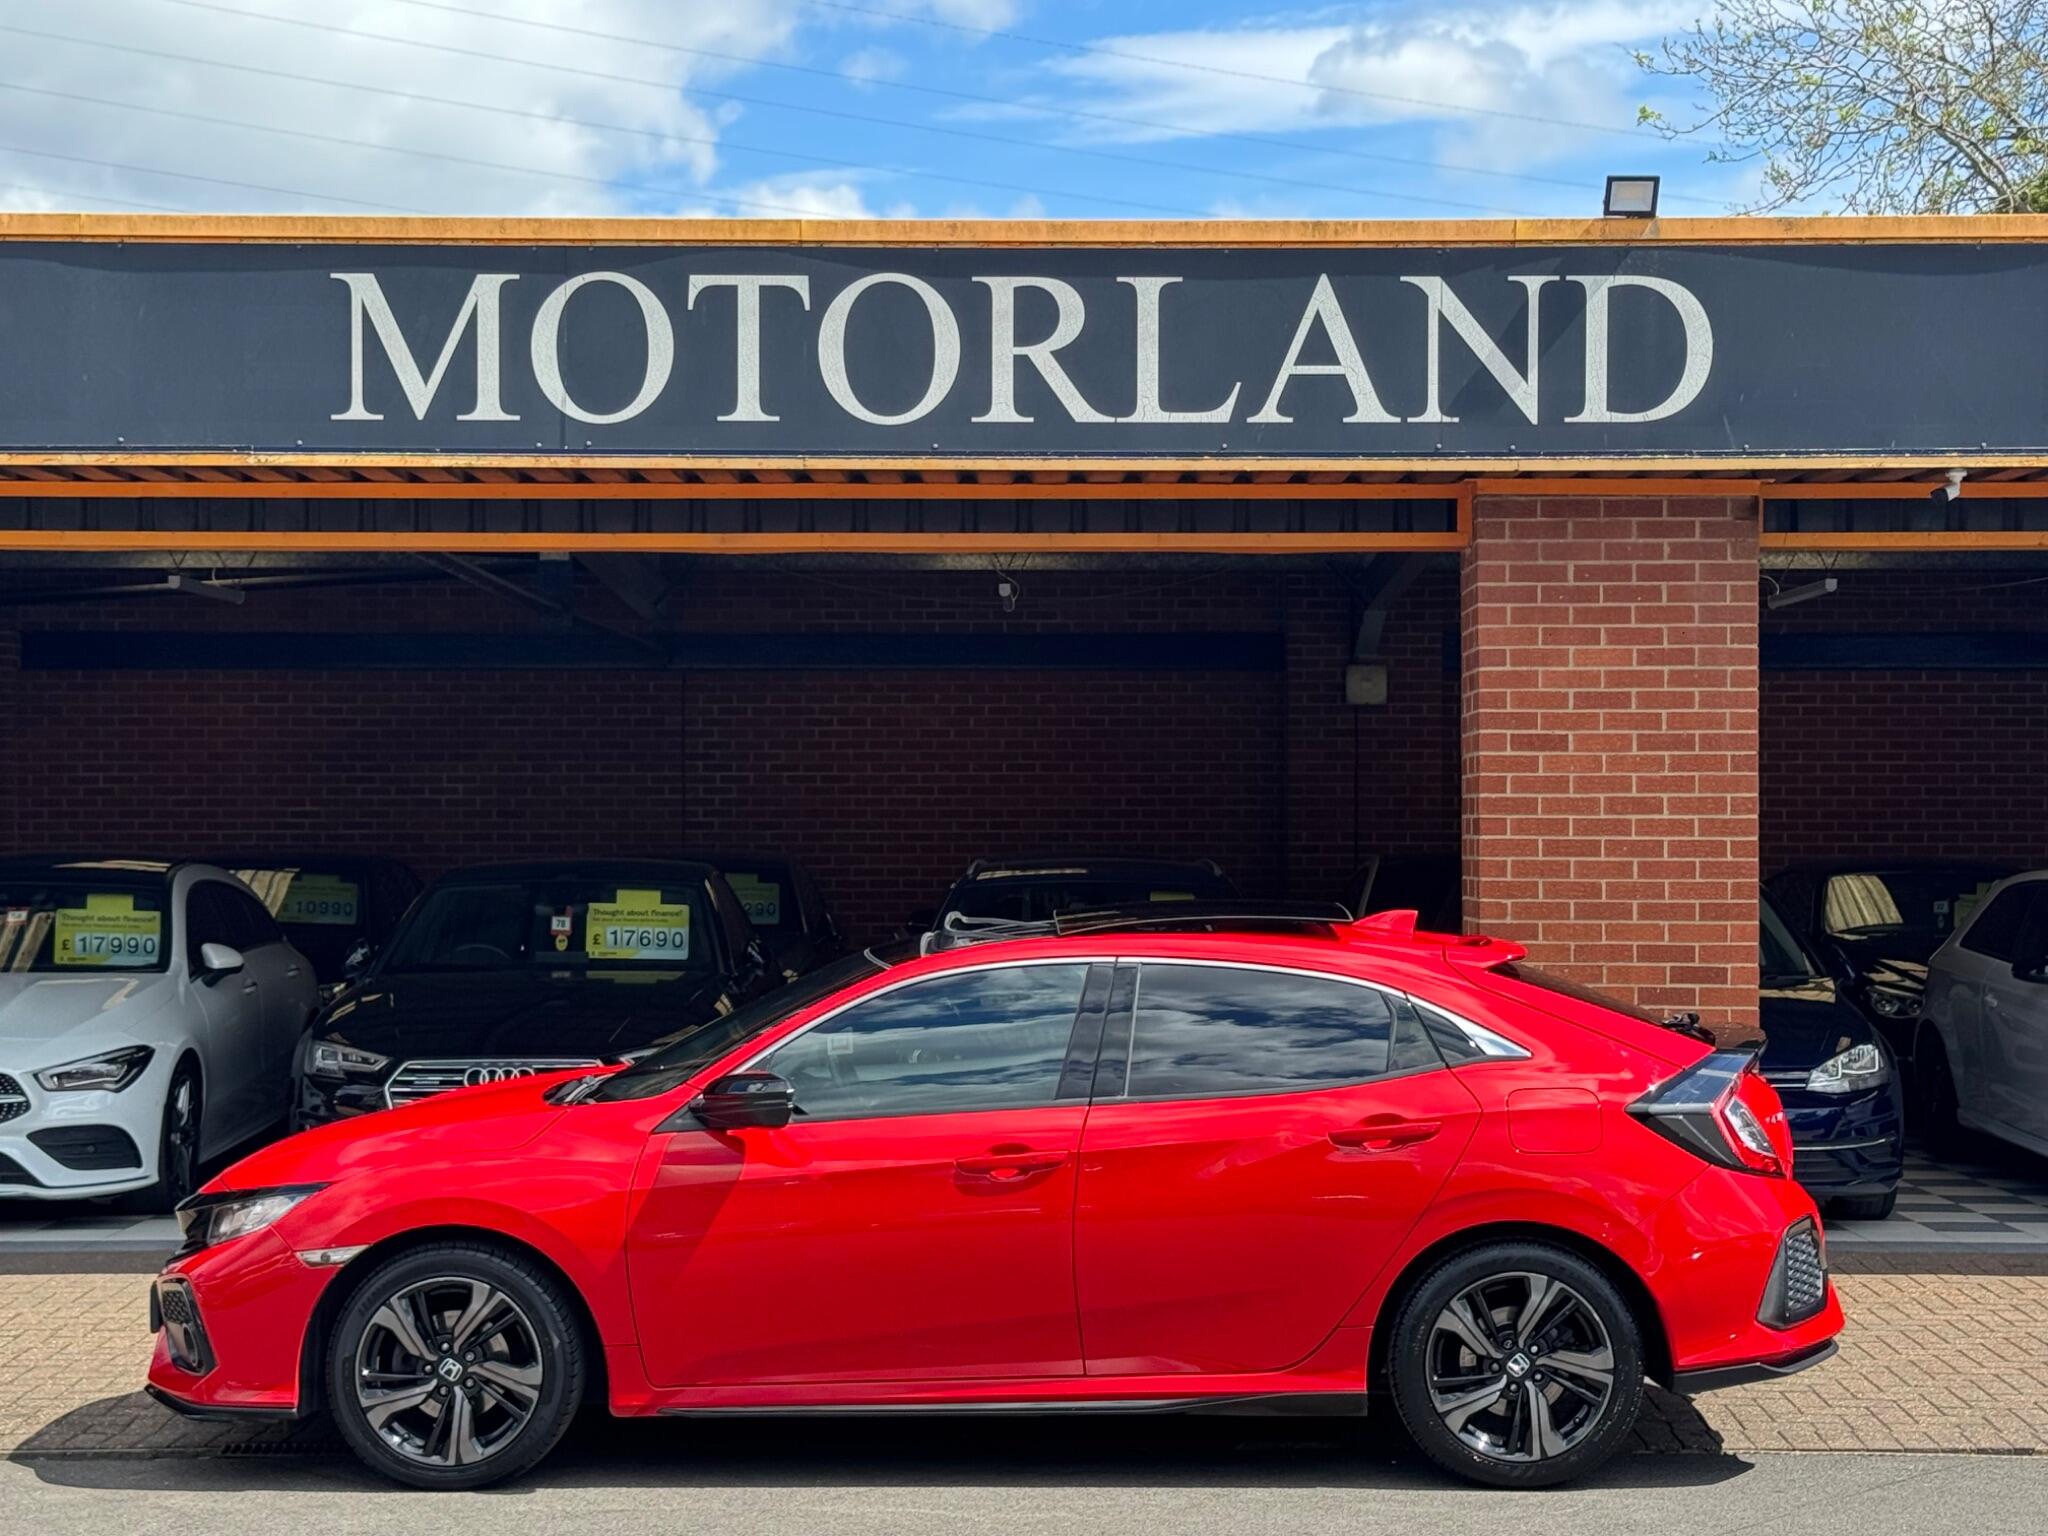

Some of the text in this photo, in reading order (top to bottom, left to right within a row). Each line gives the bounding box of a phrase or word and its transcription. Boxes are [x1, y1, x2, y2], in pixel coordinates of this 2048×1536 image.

[330, 271, 1714, 426] MOTORLAND
[61, 913, 95, 922] Thought
[97, 914, 121, 922] about
[593, 908, 625, 917] Thought
[651, 909, 683, 917] finance?
[62, 937, 155, 954] £ 17990
[593, 930, 684, 948] £ 17690
